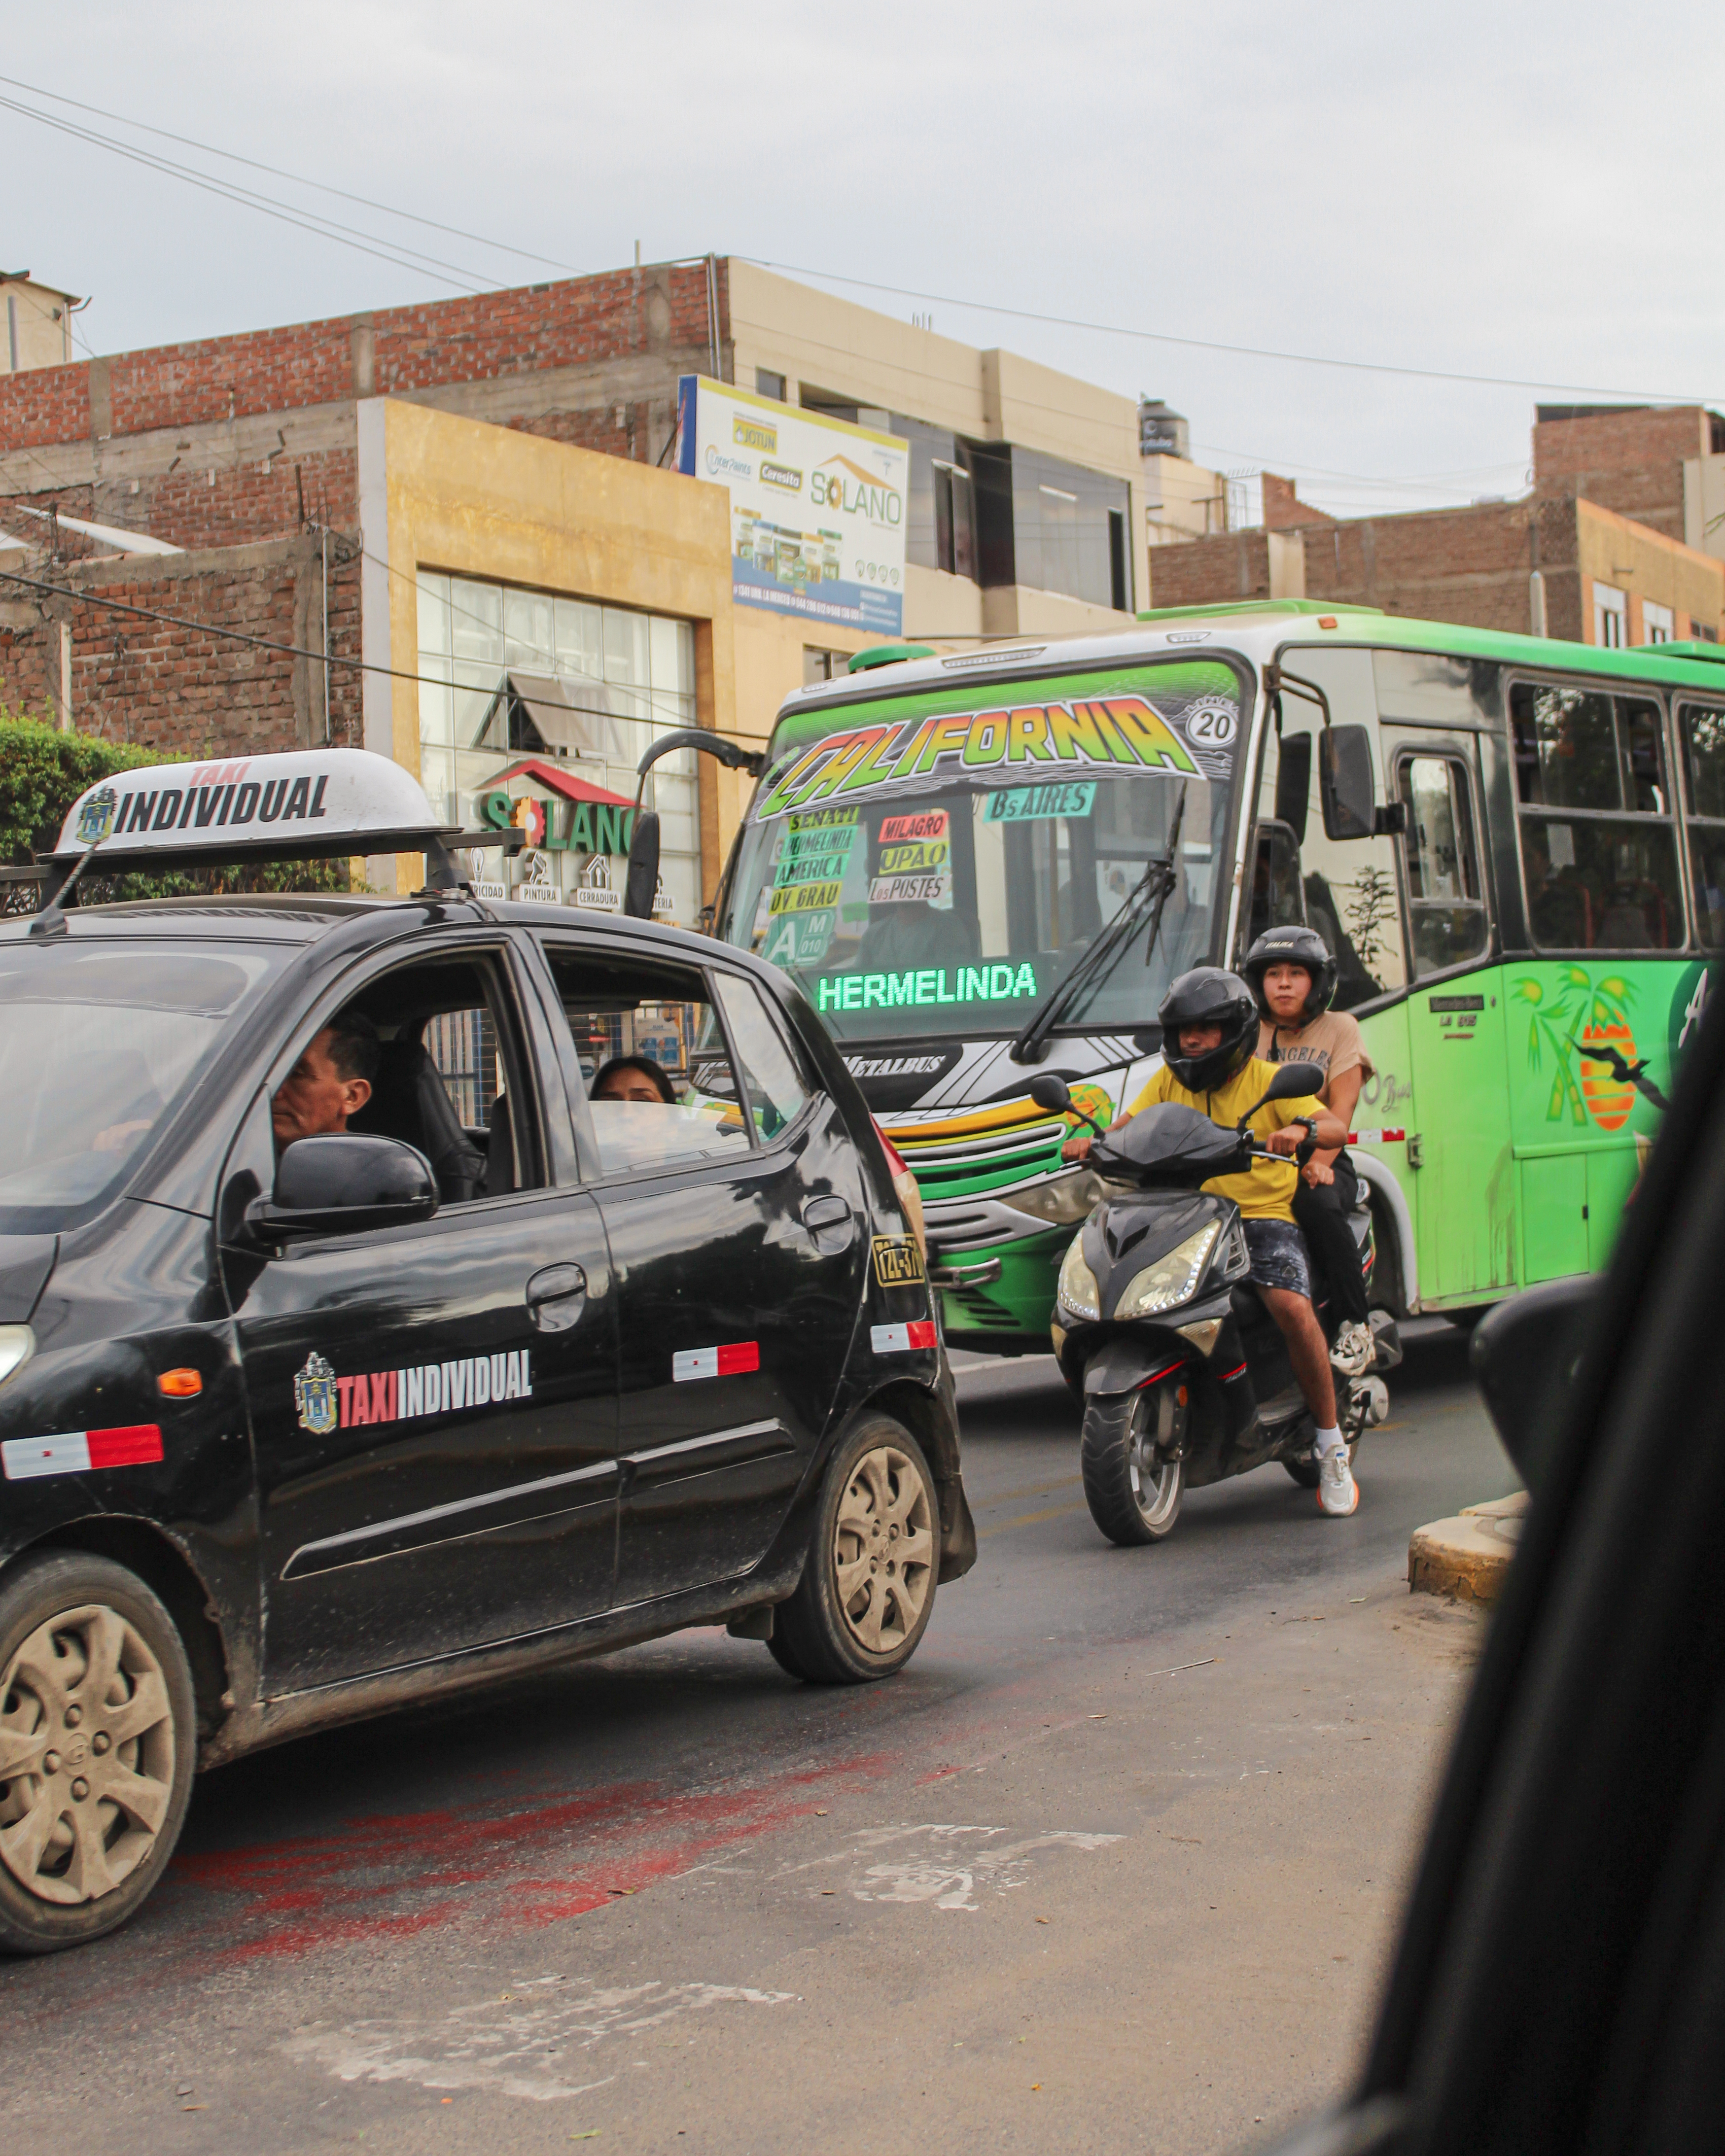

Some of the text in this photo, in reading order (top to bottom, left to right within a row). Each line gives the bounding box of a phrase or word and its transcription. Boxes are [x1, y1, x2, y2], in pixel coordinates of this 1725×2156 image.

[745, 428, 775, 450] JOTUN
[762, 464, 800, 489] Ceresita
[811, 470, 901, 525] SOLANO
[1195, 710, 1230, 739] 20
[758, 696, 1206, 821] CALIFORNIA
[189, 761, 253, 787] TAXI
[114, 774, 330, 833] INDIVIDUAL
[1019, 783, 1089, 816] AIRES
[790, 807, 858, 830] SENATI
[883, 815, 944, 839] MILAGRO
[786, 828, 853, 856] HERMELINDA
[777, 855, 842, 884] AMERICA
[879, 843, 946, 871] UPAO
[523, 888, 556, 902] PINTURA
[579, 891, 618, 906] CERRADURA
[796, 882, 839, 908] GRAU
[889, 876, 944, 899] POSTES
[808, 914, 827, 933] M
[766, 921, 795, 961] A
[800, 939, 821, 954] 010
[818, 962, 1037, 1012] HERMELINDA
[842, 1055, 946, 1077] METALBUS
[336, 1348, 533, 1429] TAXI INDIVIDUAL
